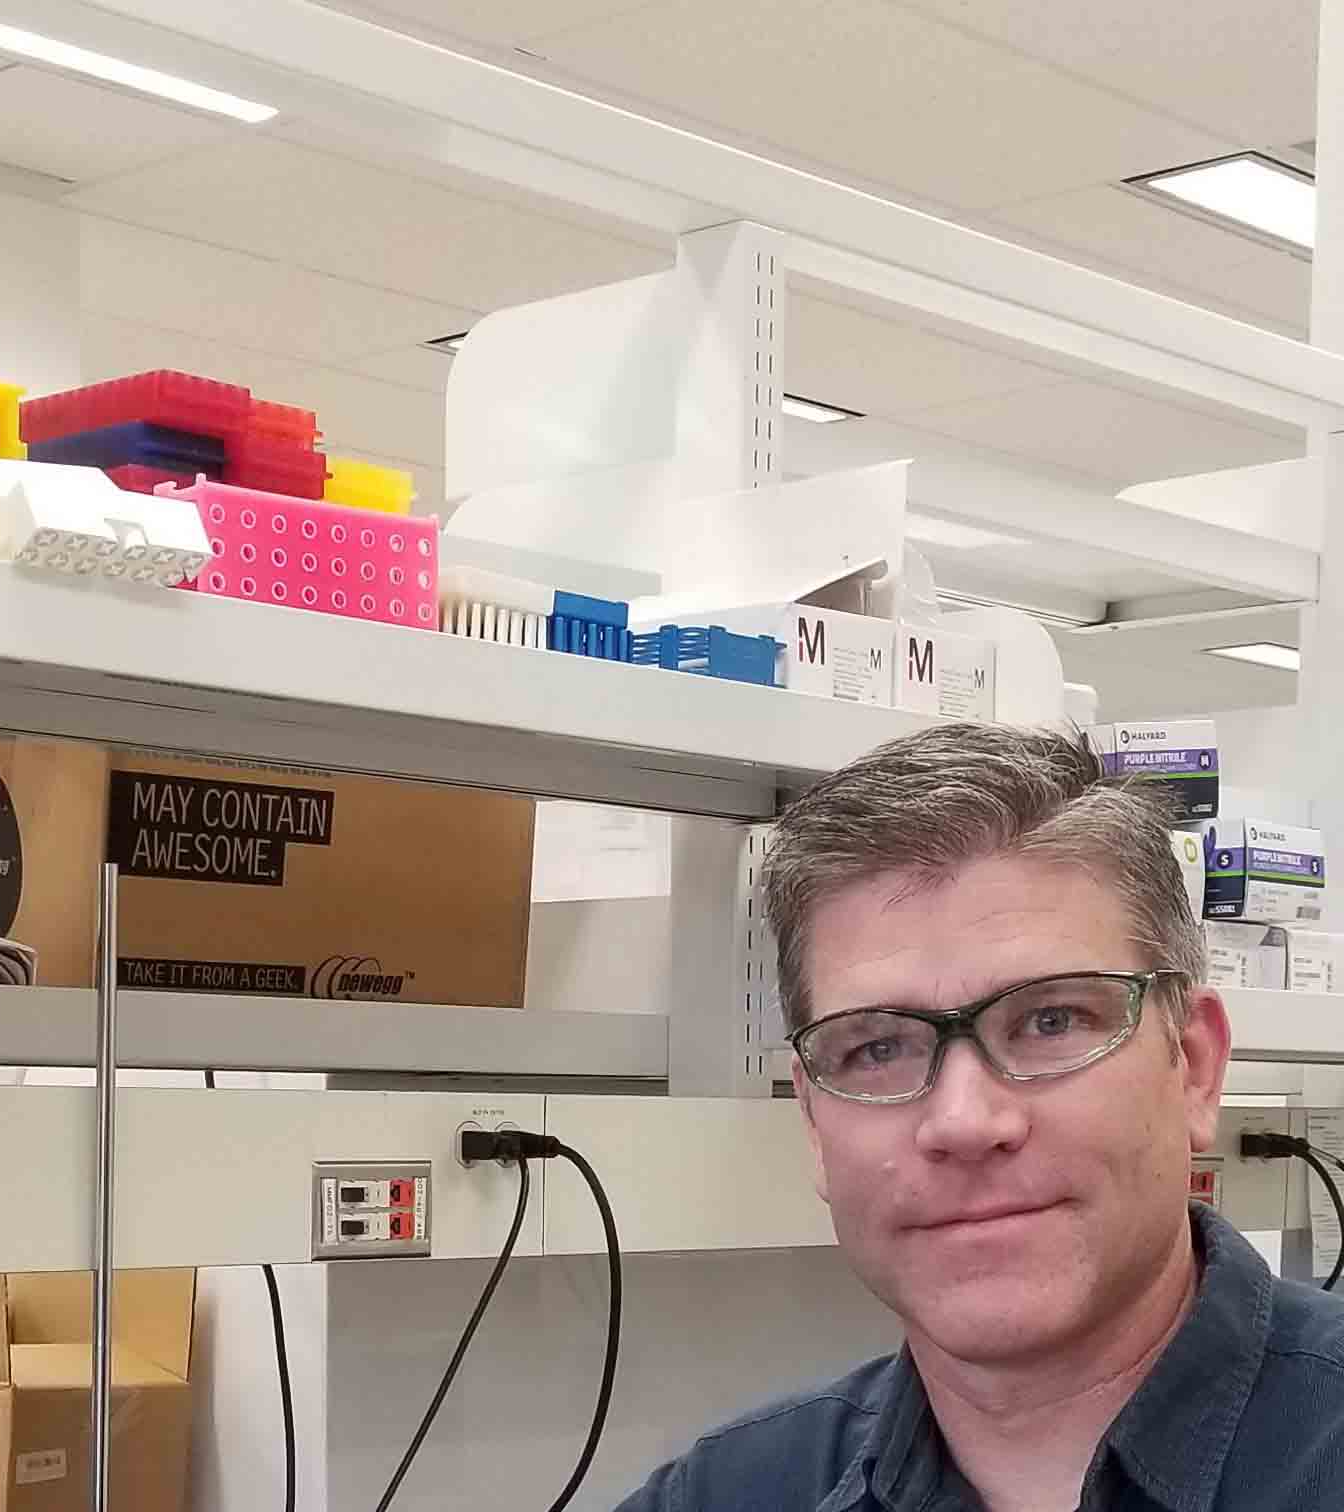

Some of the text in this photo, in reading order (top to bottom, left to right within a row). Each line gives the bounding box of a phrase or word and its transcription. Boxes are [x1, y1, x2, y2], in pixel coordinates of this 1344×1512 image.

[798, 616, 825, 665] M
[869, 648, 883, 670] M
[908, 637, 934, 685] M
[974, 668, 986, 689] M
[132, 781, 328, 837] MAY CONTAIN
[130, 828, 278, 879] AWESOME.
[1220, 854, 1230, 866] S
[124, 961, 300, 990] TAKE IT FROM A GEEK.
[336, 971, 405, 994] newegg
